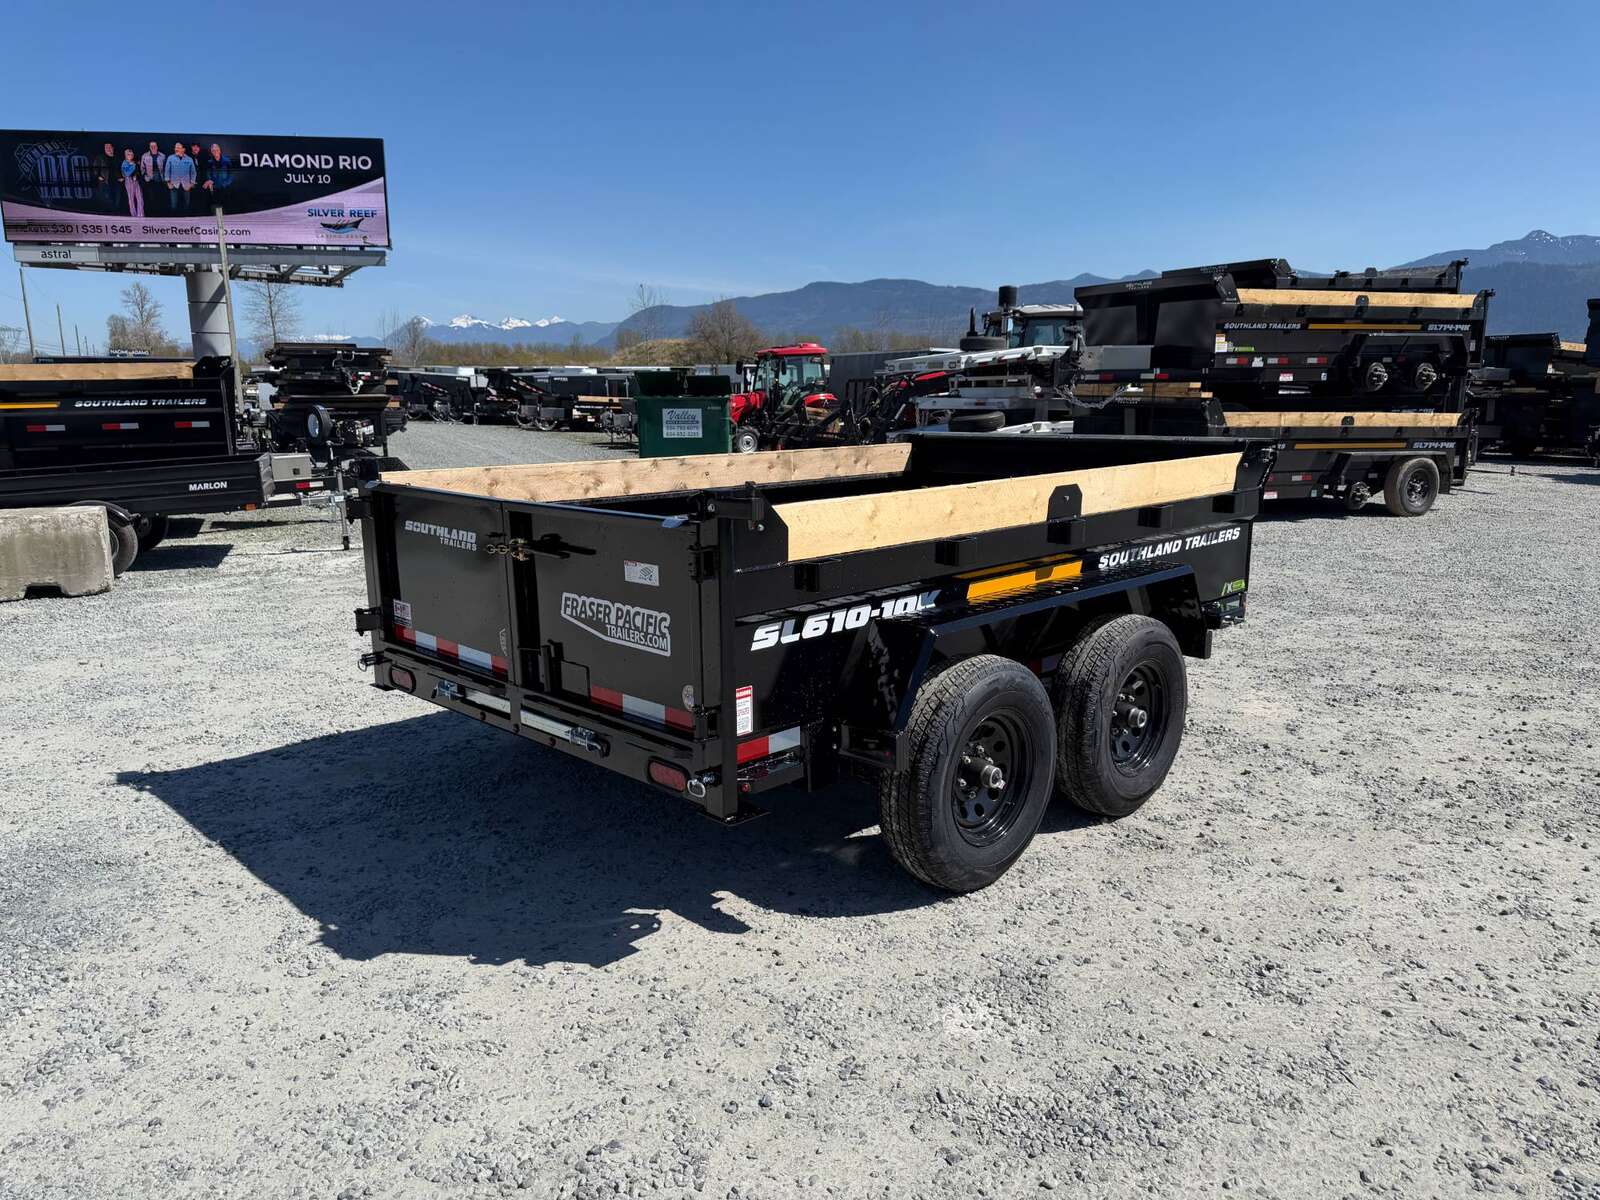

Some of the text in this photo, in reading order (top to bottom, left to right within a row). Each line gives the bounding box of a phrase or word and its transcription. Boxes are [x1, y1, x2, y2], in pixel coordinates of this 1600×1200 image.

[239, 153, 372, 170] DIAMOND RIO
[284, 173, 331, 184] JULY 10
[307, 208, 377, 219] SILVER REEF
[51, 224, 74, 235] $30
[81, 225, 103, 235] $35
[111, 225, 132, 235] $45
[142, 226, 251, 236] SilverReefCasio.com
[41, 249, 72, 260] astral
[74, 398, 207, 408] SOUTHLAND TRAILERS
[667, 409, 697, 420] Valley
[189, 481, 228, 491] MARLON
[405, 520, 477, 543] SOUTHLAND
[440, 537, 477, 551] TRAILERS
[1098, 527, 1241, 569] SOUTHLAND TRAILERS
[563, 597, 669, 637] FRASER PACIFIC
[751, 589, 941, 651] SL610-10K
[606, 624, 668, 651] TRAILERS.COM
